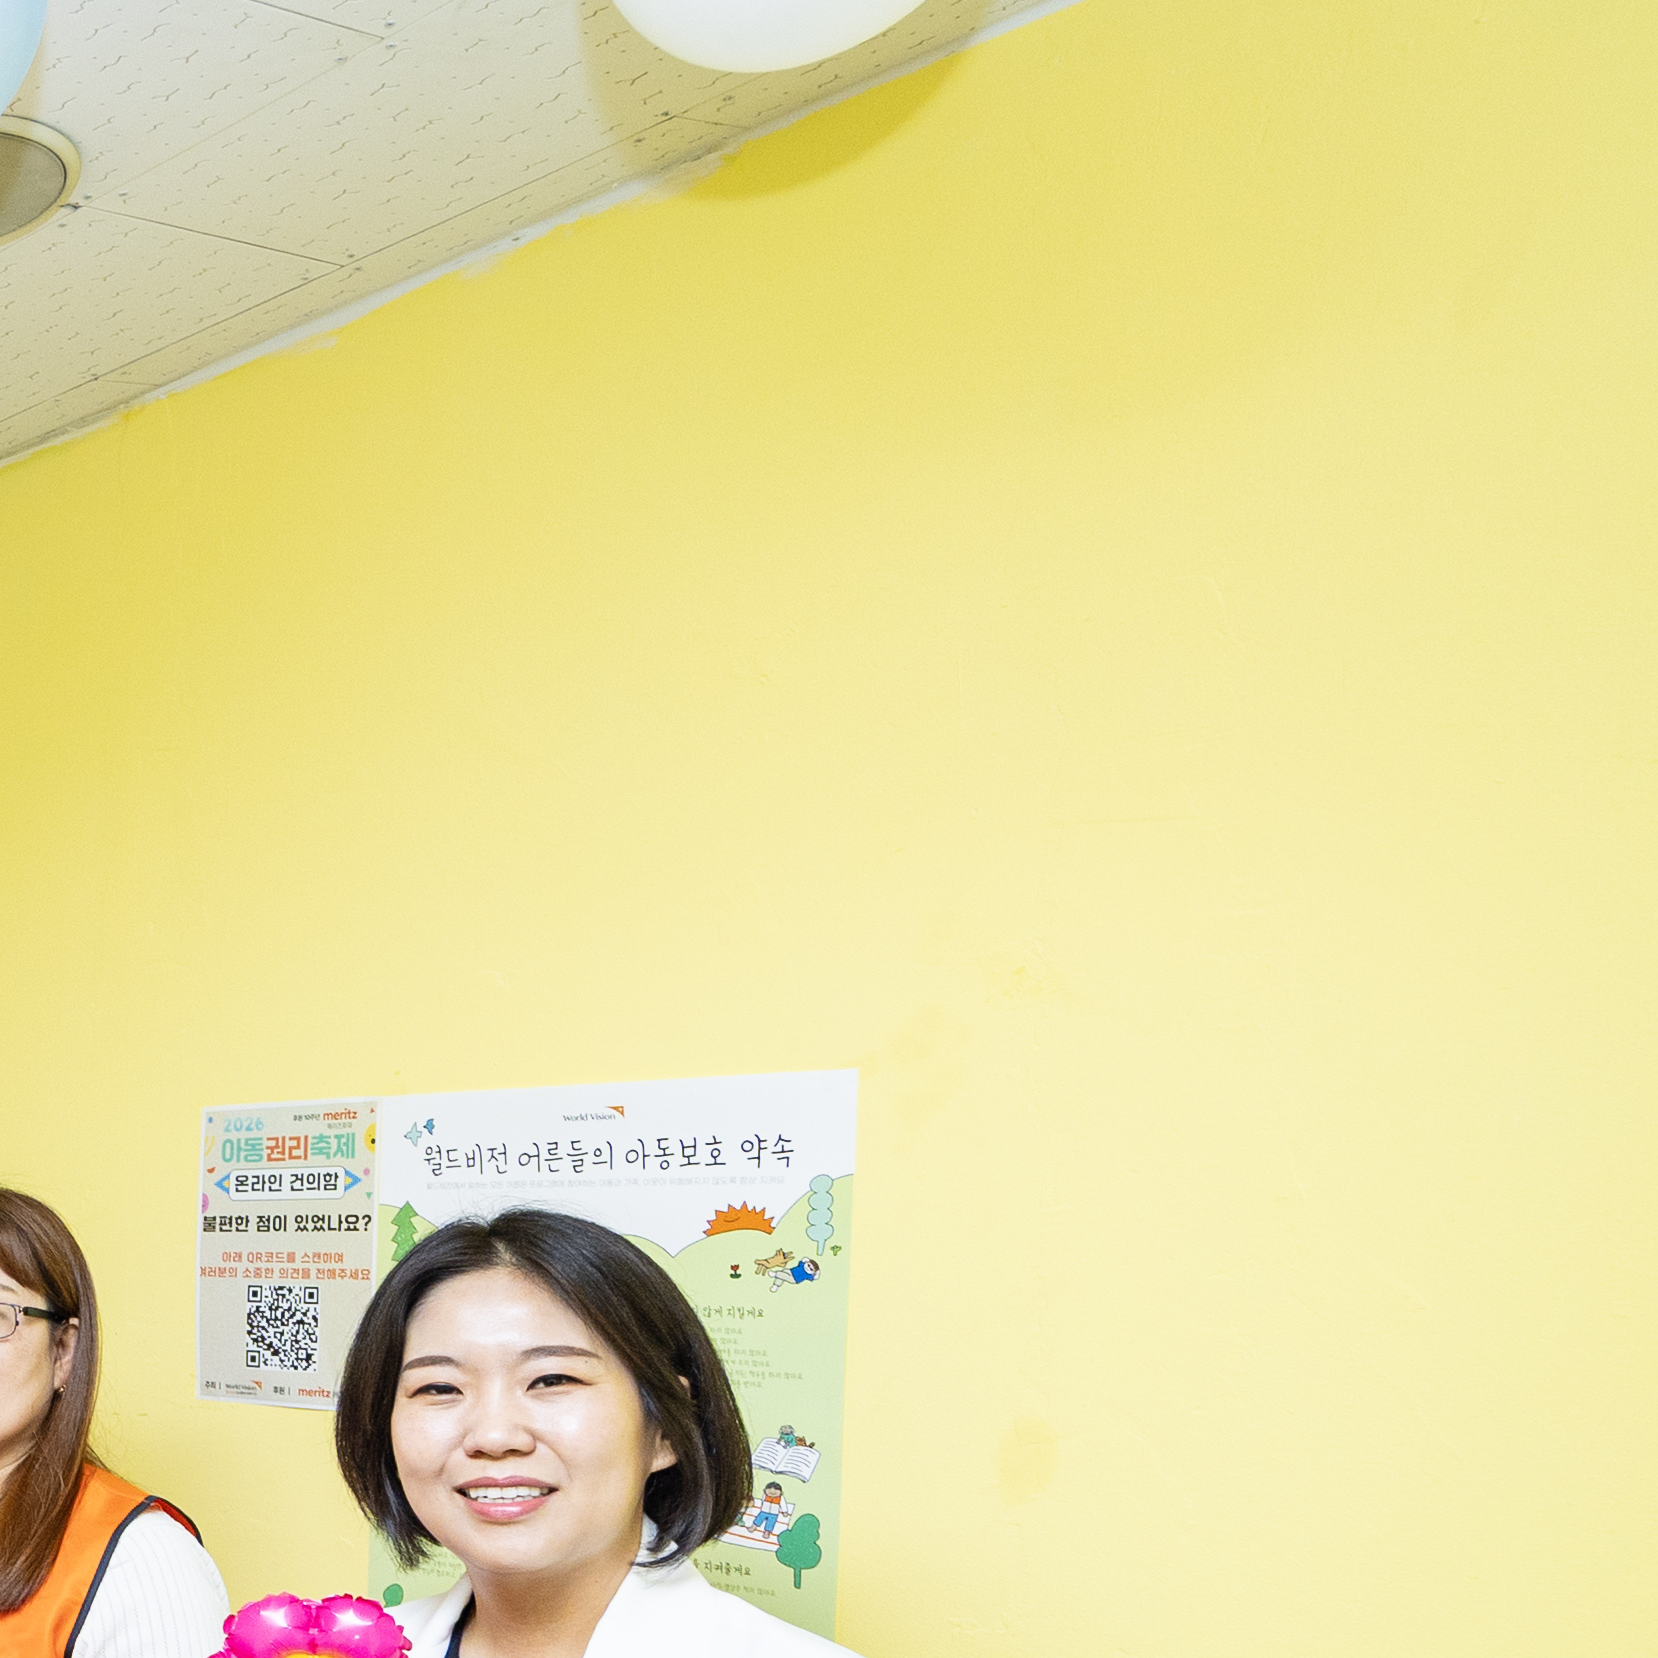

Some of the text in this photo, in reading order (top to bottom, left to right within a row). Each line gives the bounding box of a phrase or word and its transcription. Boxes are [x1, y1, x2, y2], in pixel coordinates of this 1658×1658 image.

[323, 1107, 358, 1121] meritz
[563, 1112, 616, 1122] World Vision
[223, 1117, 264, 1133] 2026
[222, 1132, 356, 1163] 아동권리축제
[424, 1134, 794, 1176] 월드비전 어른들의 아동보호 약속
[235, 1172, 339, 1193] 온라인 건의함
[203, 1214, 372, 1232] 불편한 점이 있었나요?
[222, 1252, 344, 1264] 아래 QR코드를 스캔하여
[200, 1267, 371, 1281] 여러분의 소중한 의견을 전해주세요
[298, 1387, 331, 1398] meritz
